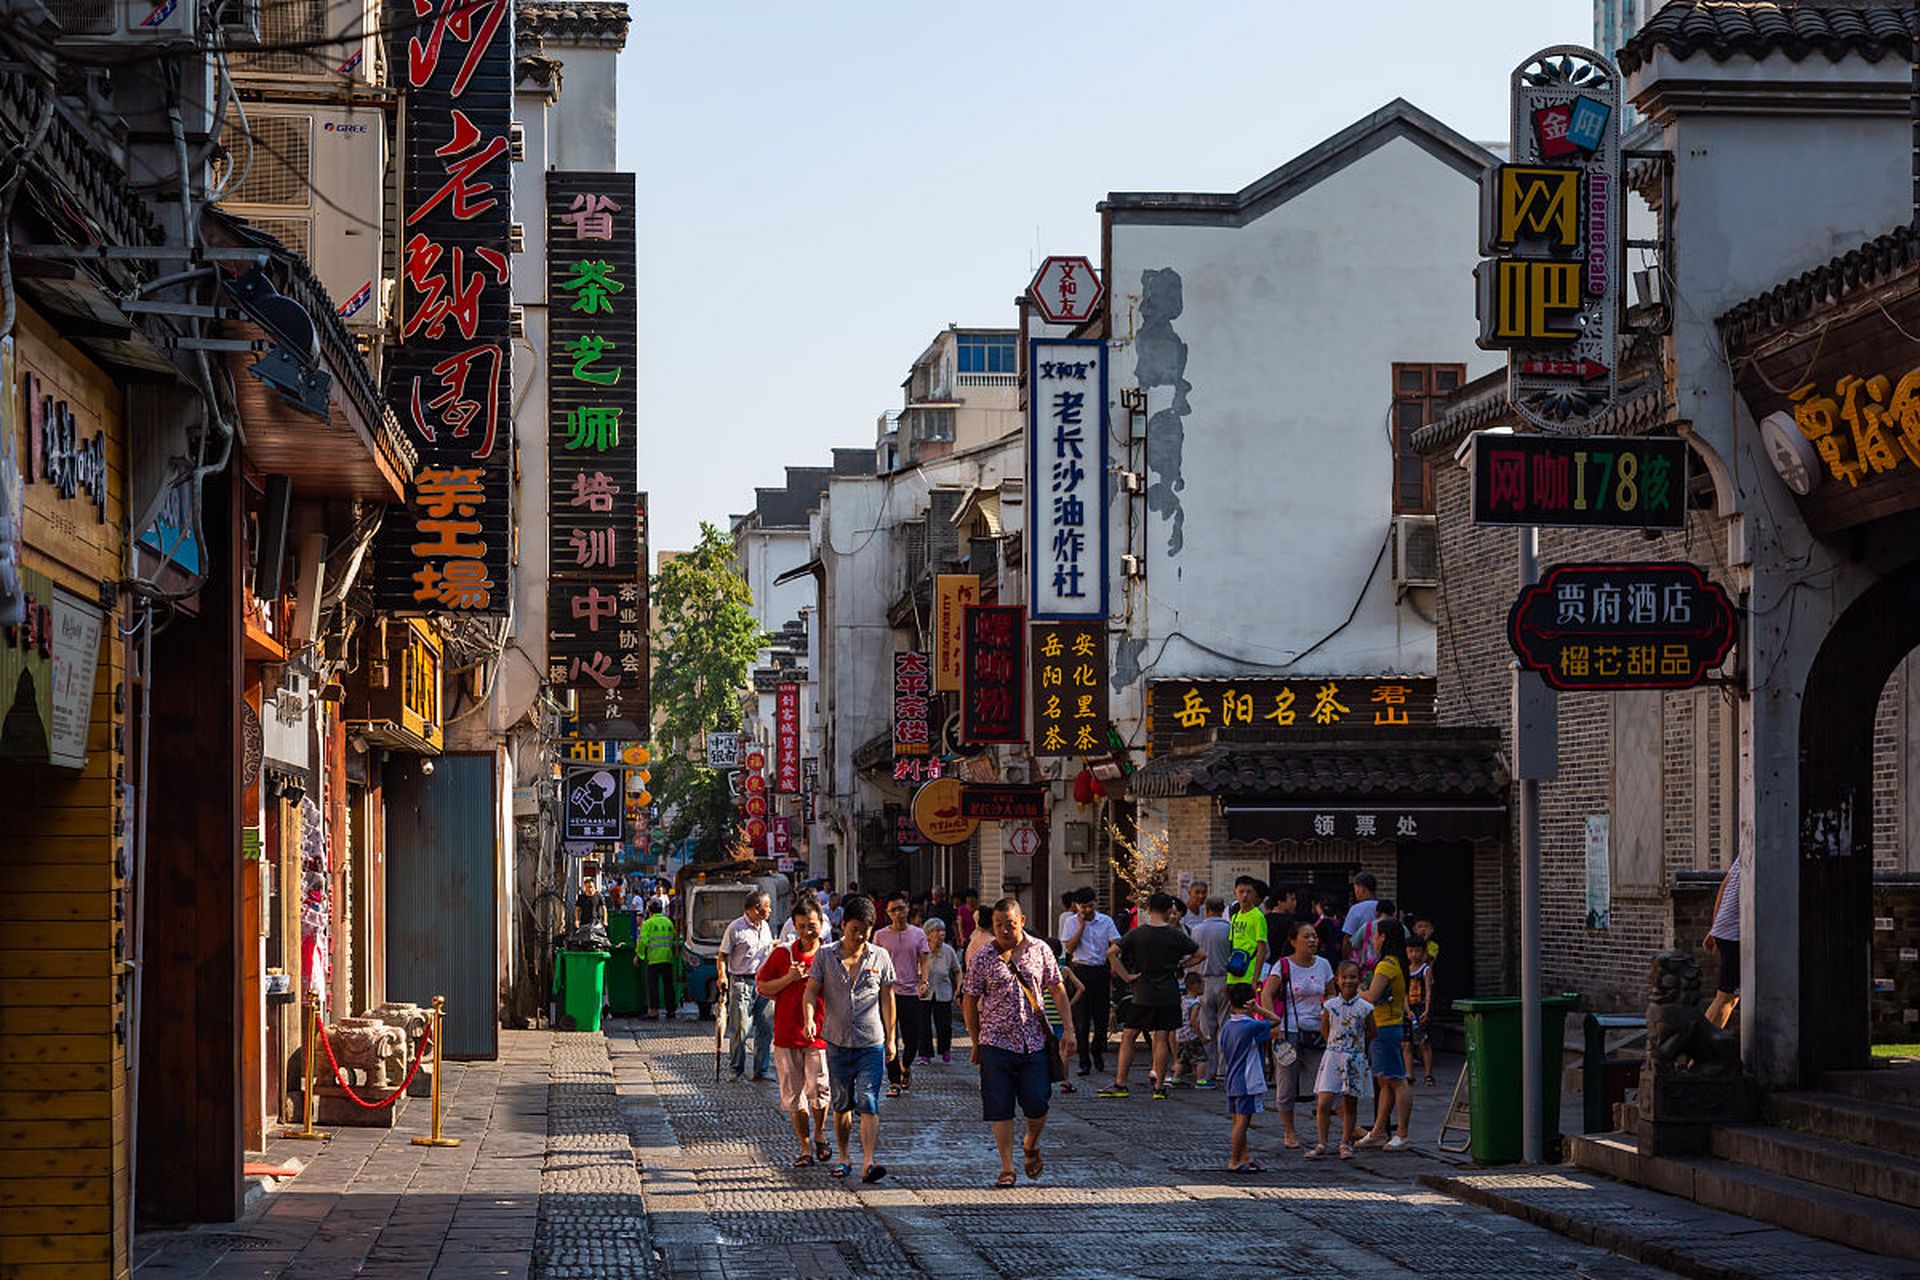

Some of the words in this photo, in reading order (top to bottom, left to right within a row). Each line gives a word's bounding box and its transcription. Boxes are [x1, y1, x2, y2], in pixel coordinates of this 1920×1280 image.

[336, 125, 366, 133] GREE
[1498, 167, 1583, 337] 网吧
[1058, 262, 1077, 316] 文和友
[1040, 360, 1088, 380] 文和友
[1052, 391, 1086, 598] 老长沙油炸社
[1556, 582, 1692, 625] 贾府酒店
[618, 582, 639, 673] 茶业协会
[1560, 644, 1691, 676] 榴芯甜品
[1040, 632, 1068, 751] 岳阳名茶
[1071, 633, 1099, 751] 安化黑茶
[1173, 683, 1350, 728] 岳阳名茶
[1371, 685, 1413, 726] 君山
[1314, 814, 1417, 836] 领票处
